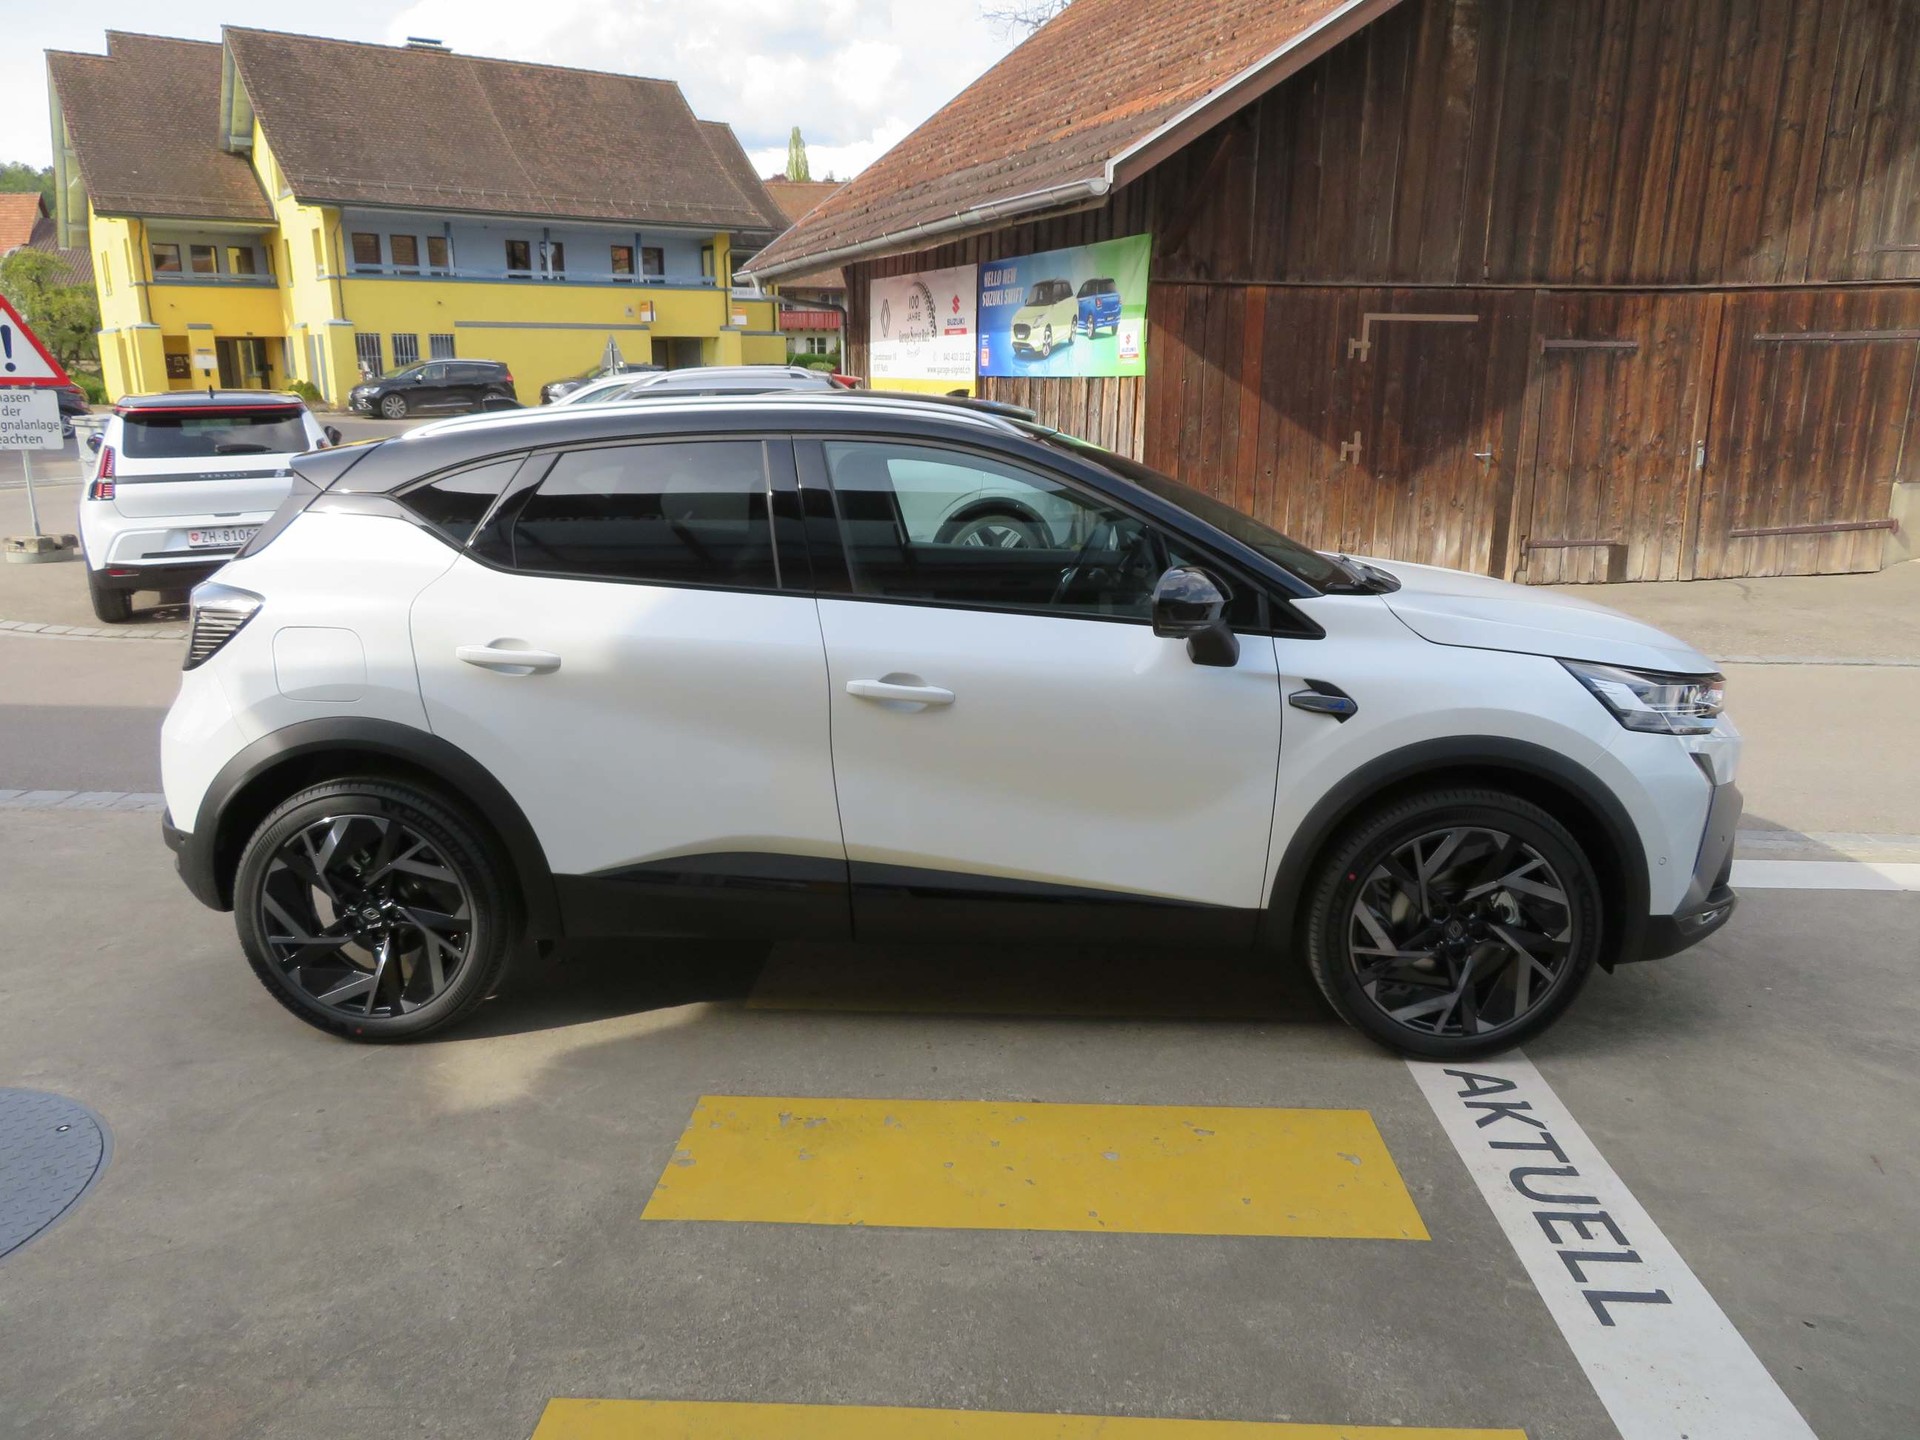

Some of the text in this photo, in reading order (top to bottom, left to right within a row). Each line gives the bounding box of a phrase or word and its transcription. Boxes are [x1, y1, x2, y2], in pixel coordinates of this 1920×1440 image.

[984, 267, 1017, 287] HELLO NEW
[908, 294, 920, 310] 100
[982, 287, 1024, 307] SUZUKI SWIFT
[947, 318, 966, 326] SUZUKI
[1, 405, 21, 416] der
[1442, 1068, 1673, 1327] AKTUELL
